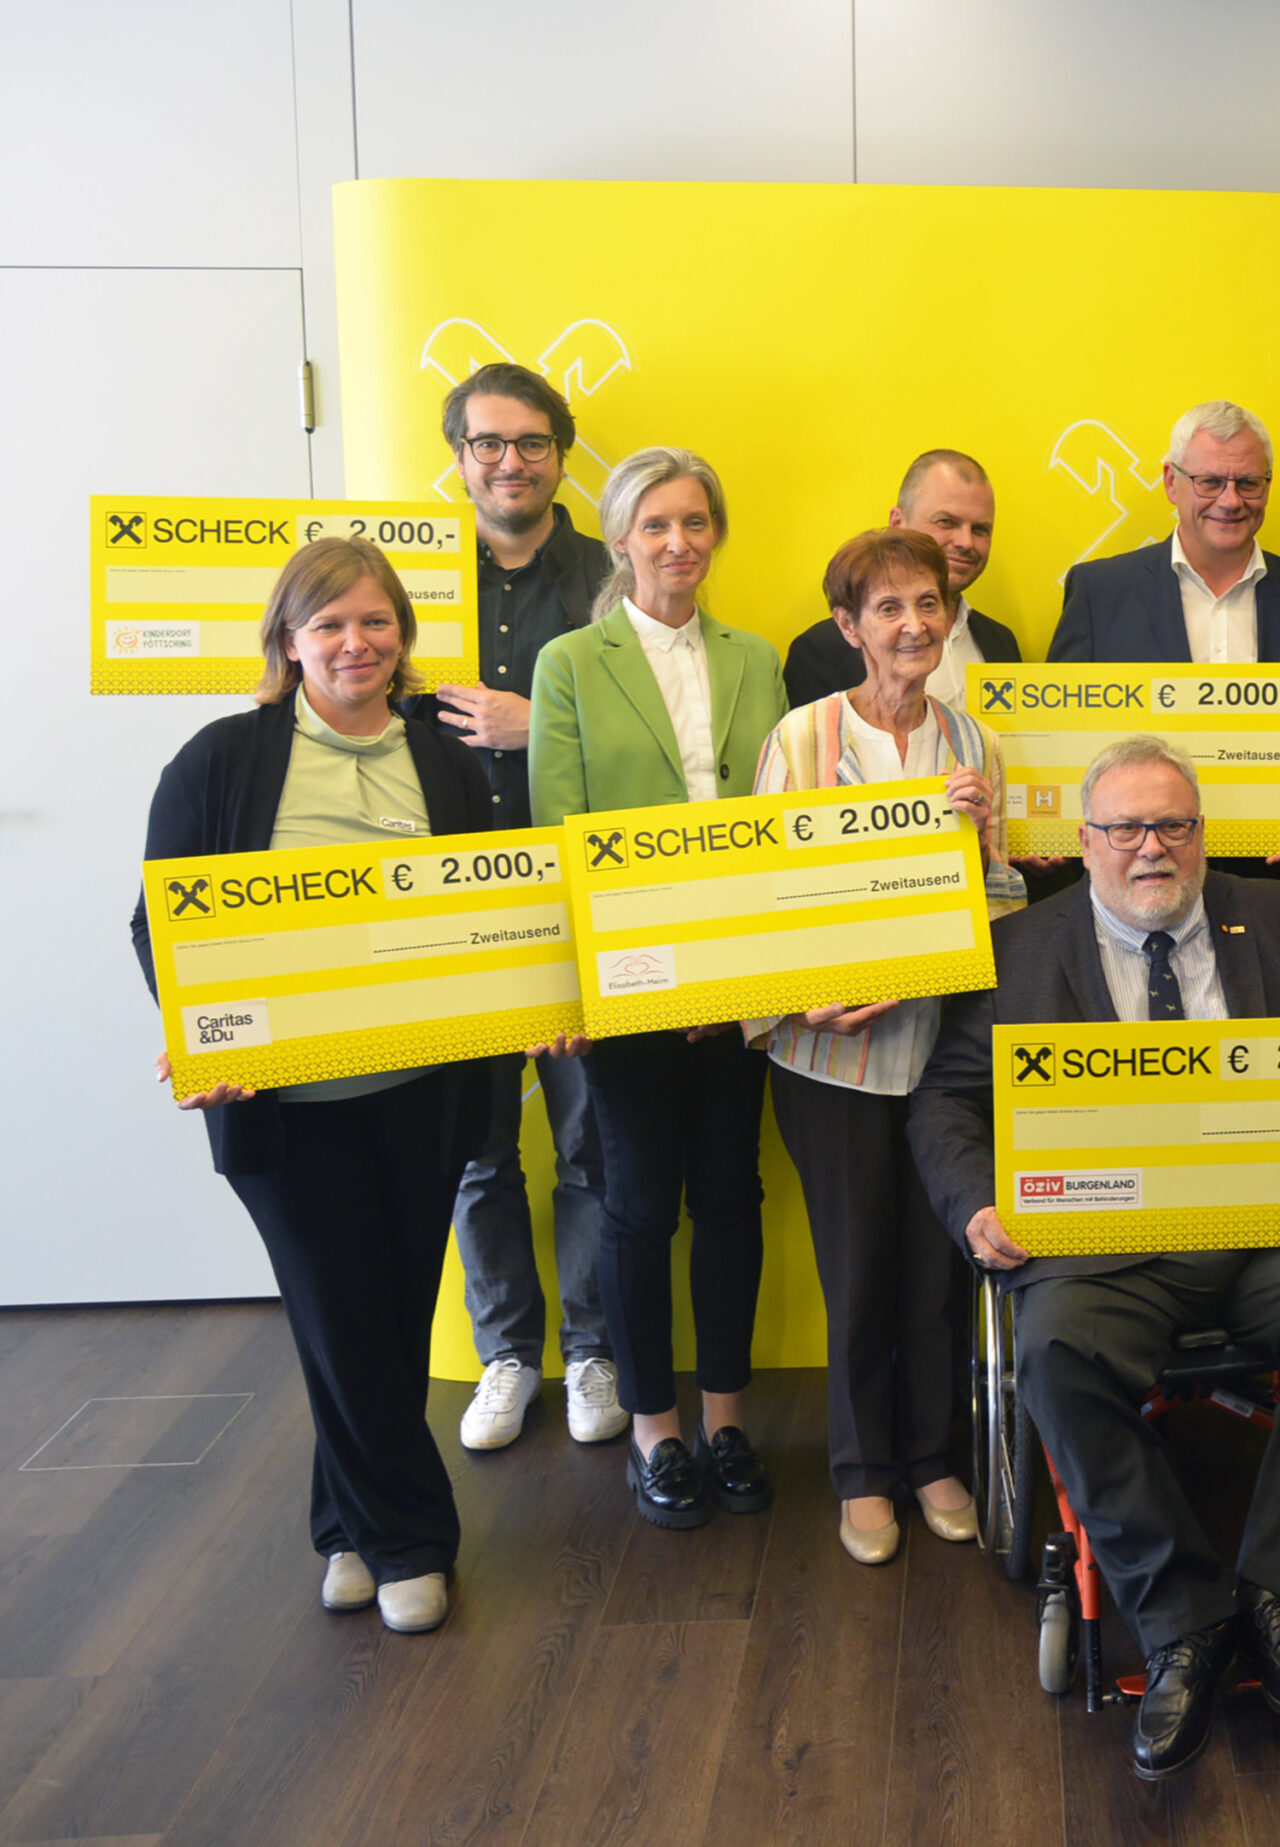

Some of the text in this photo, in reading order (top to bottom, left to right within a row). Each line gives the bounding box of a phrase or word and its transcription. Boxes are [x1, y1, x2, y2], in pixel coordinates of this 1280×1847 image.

[153, 518, 456, 550] SCHECK € 2.000,-
[407, 589, 455, 600] ausend
[1021, 684, 1144, 708] SCHECK
[1157, 684, 1176, 708] €
[634, 799, 954, 859] SCHECK € 2.000,-
[221, 851, 556, 909] SCHECK € 2.000,-
[870, 872, 960, 893] Zweitausend
[470, 924, 561, 946] Zweitausend
[197, 1012, 254, 1030] Caritas
[199, 1028, 235, 1045] &Du
[1062, 1046, 1212, 1078] SCHECK
[1227, 1045, 1249, 1074] €
[1066, 1180, 1135, 1190] BURGENLAND
